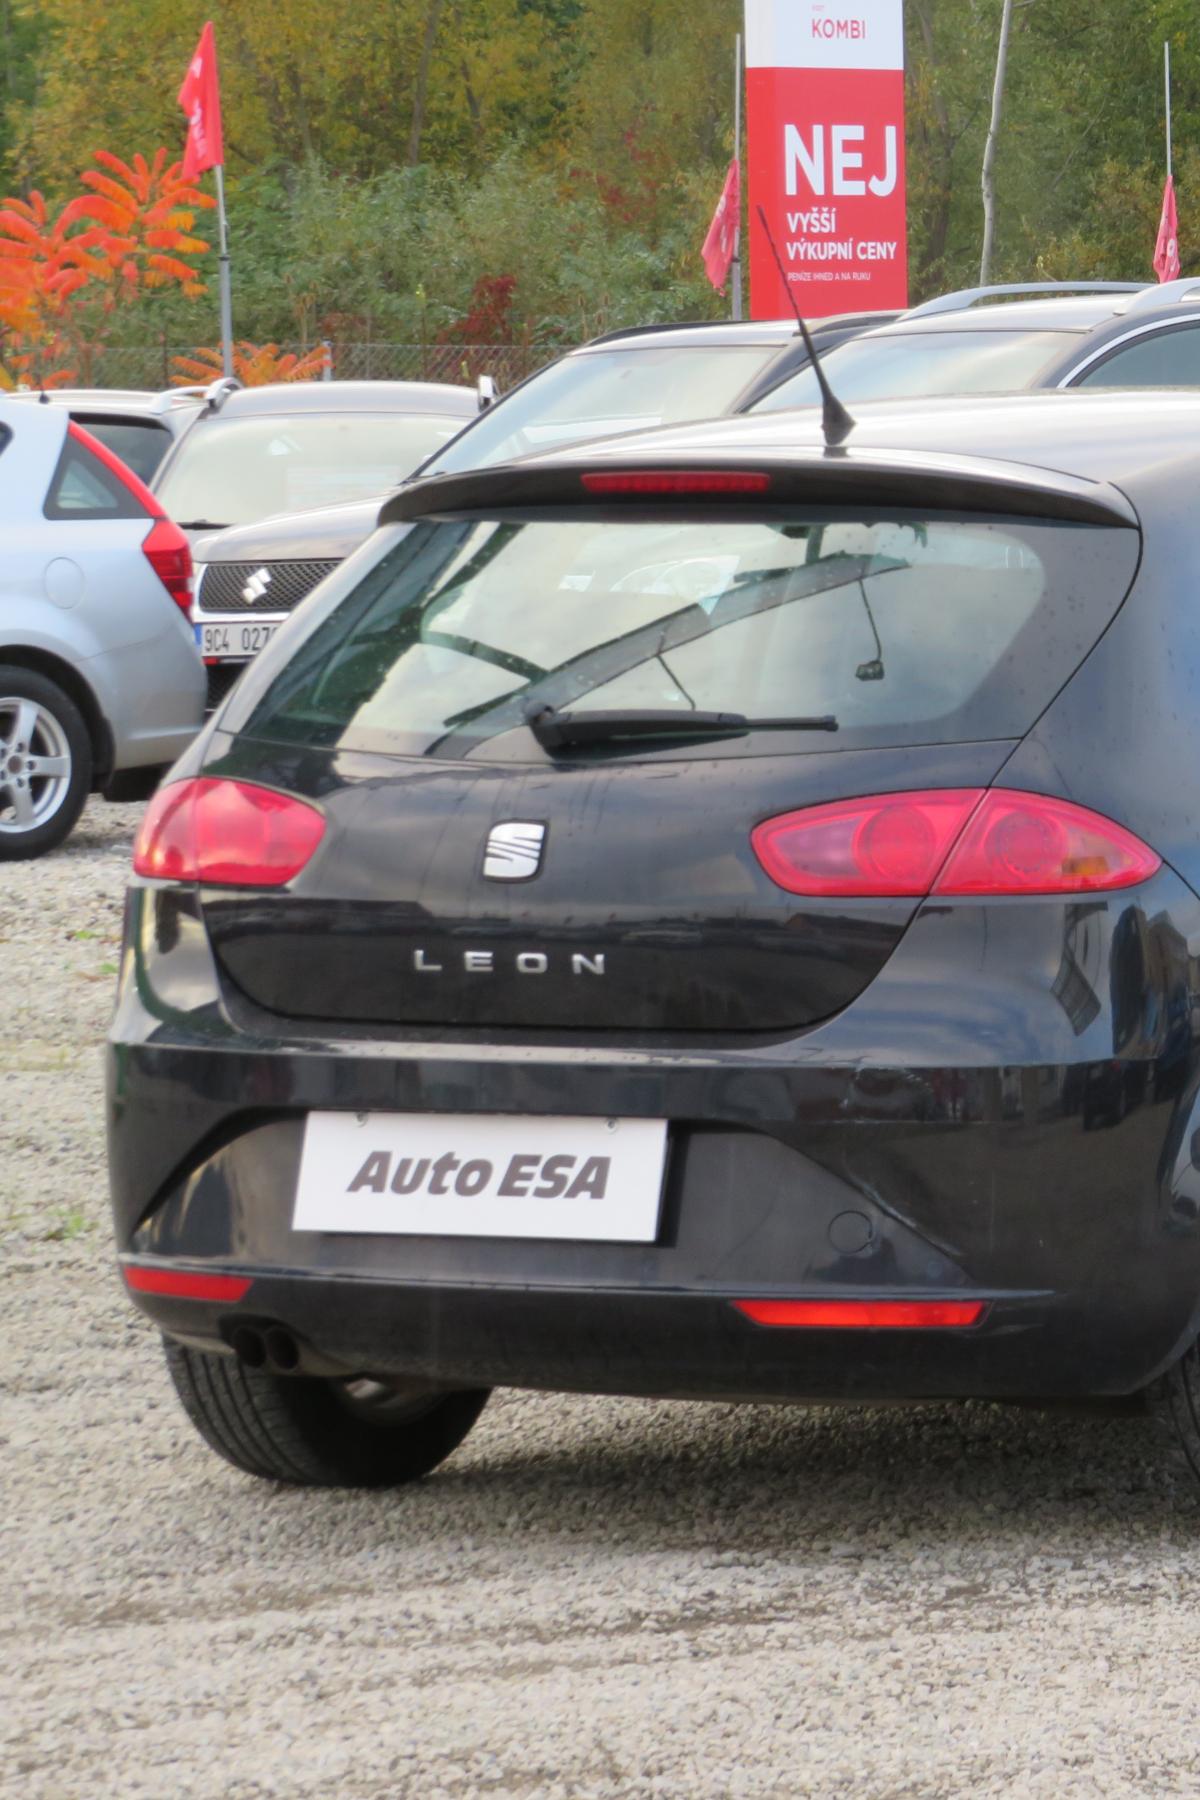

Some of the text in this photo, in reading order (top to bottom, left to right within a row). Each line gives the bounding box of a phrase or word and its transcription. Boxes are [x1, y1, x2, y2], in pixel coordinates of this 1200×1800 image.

[811, 18, 866, 40] KOMBI
[784, 124, 897, 197] NEJ
[786, 207, 836, 233] VYŠŠÍ
[786, 237, 897, 260] VÝKUPNÍ CENY
[205, 626, 278, 652] 9C4 027
[414, 949, 605, 975] LEON
[345, 1150, 612, 1200] Auto ESA
